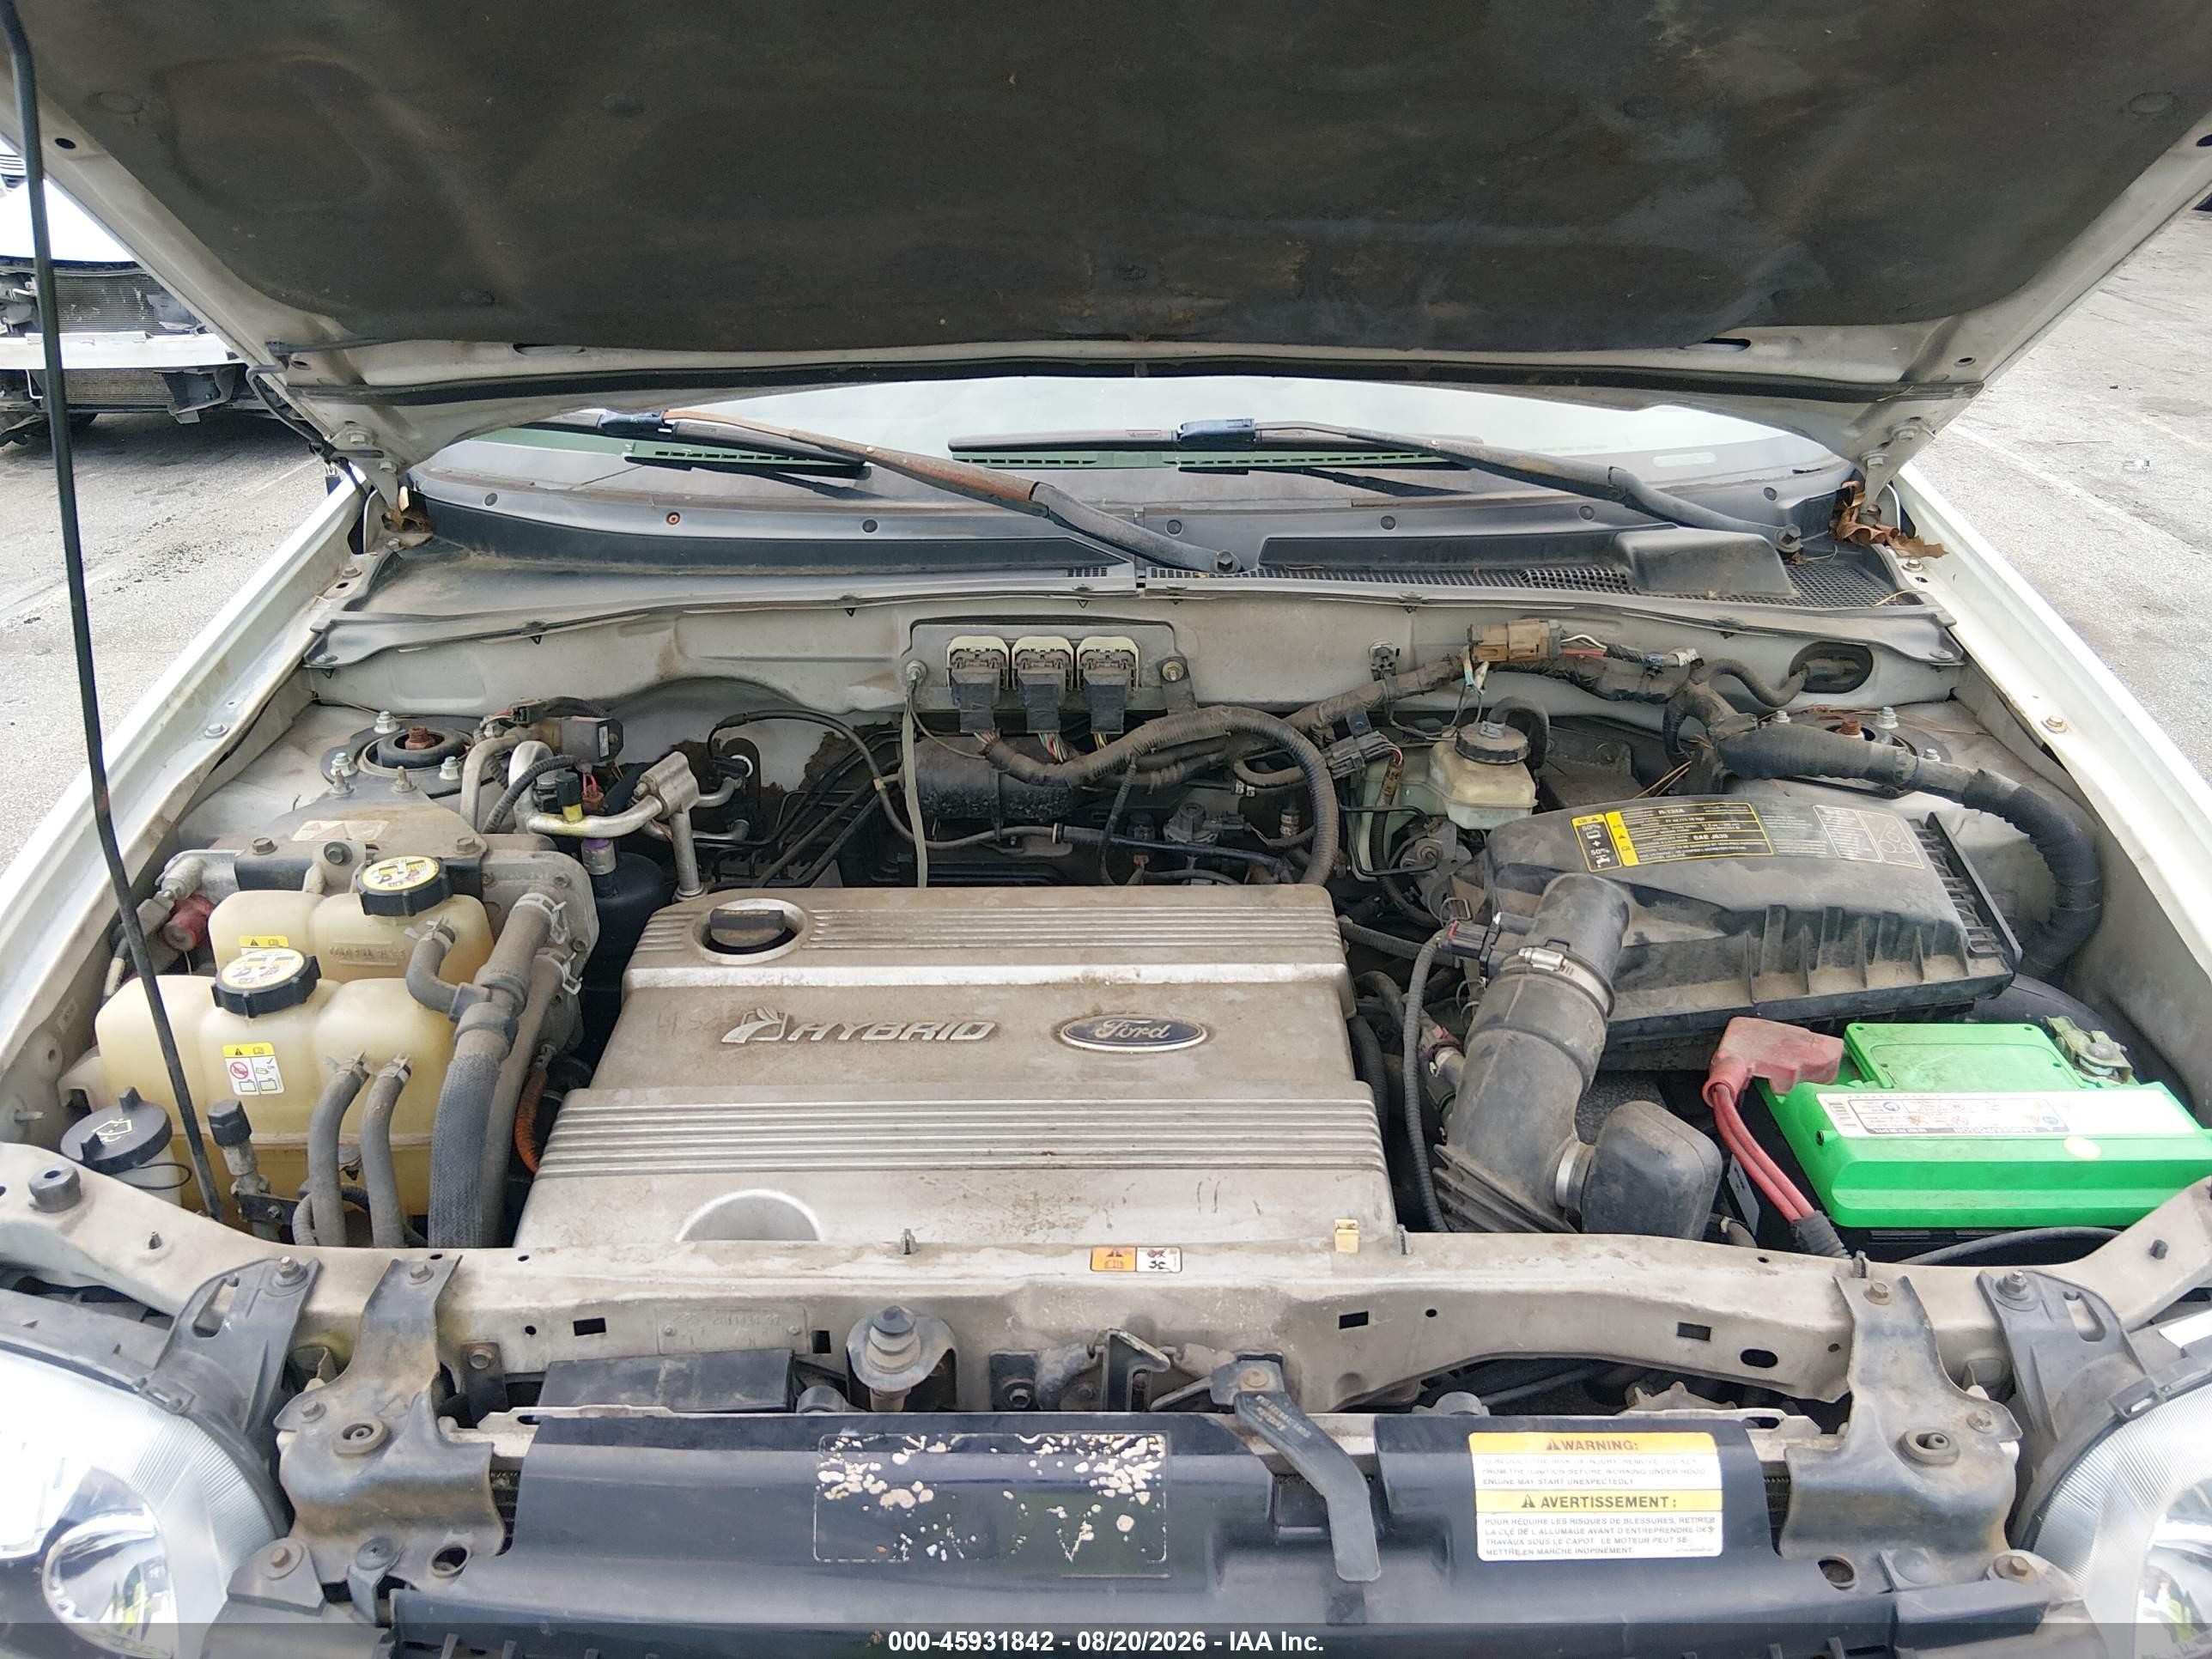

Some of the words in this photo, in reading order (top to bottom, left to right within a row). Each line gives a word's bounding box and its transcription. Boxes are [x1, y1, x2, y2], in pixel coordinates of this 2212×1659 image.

[787, 1022, 996, 1042] HYBRID
[1092, 1018, 1170, 1039] Ford
[1559, 1440, 1639, 1451] WARNING:
